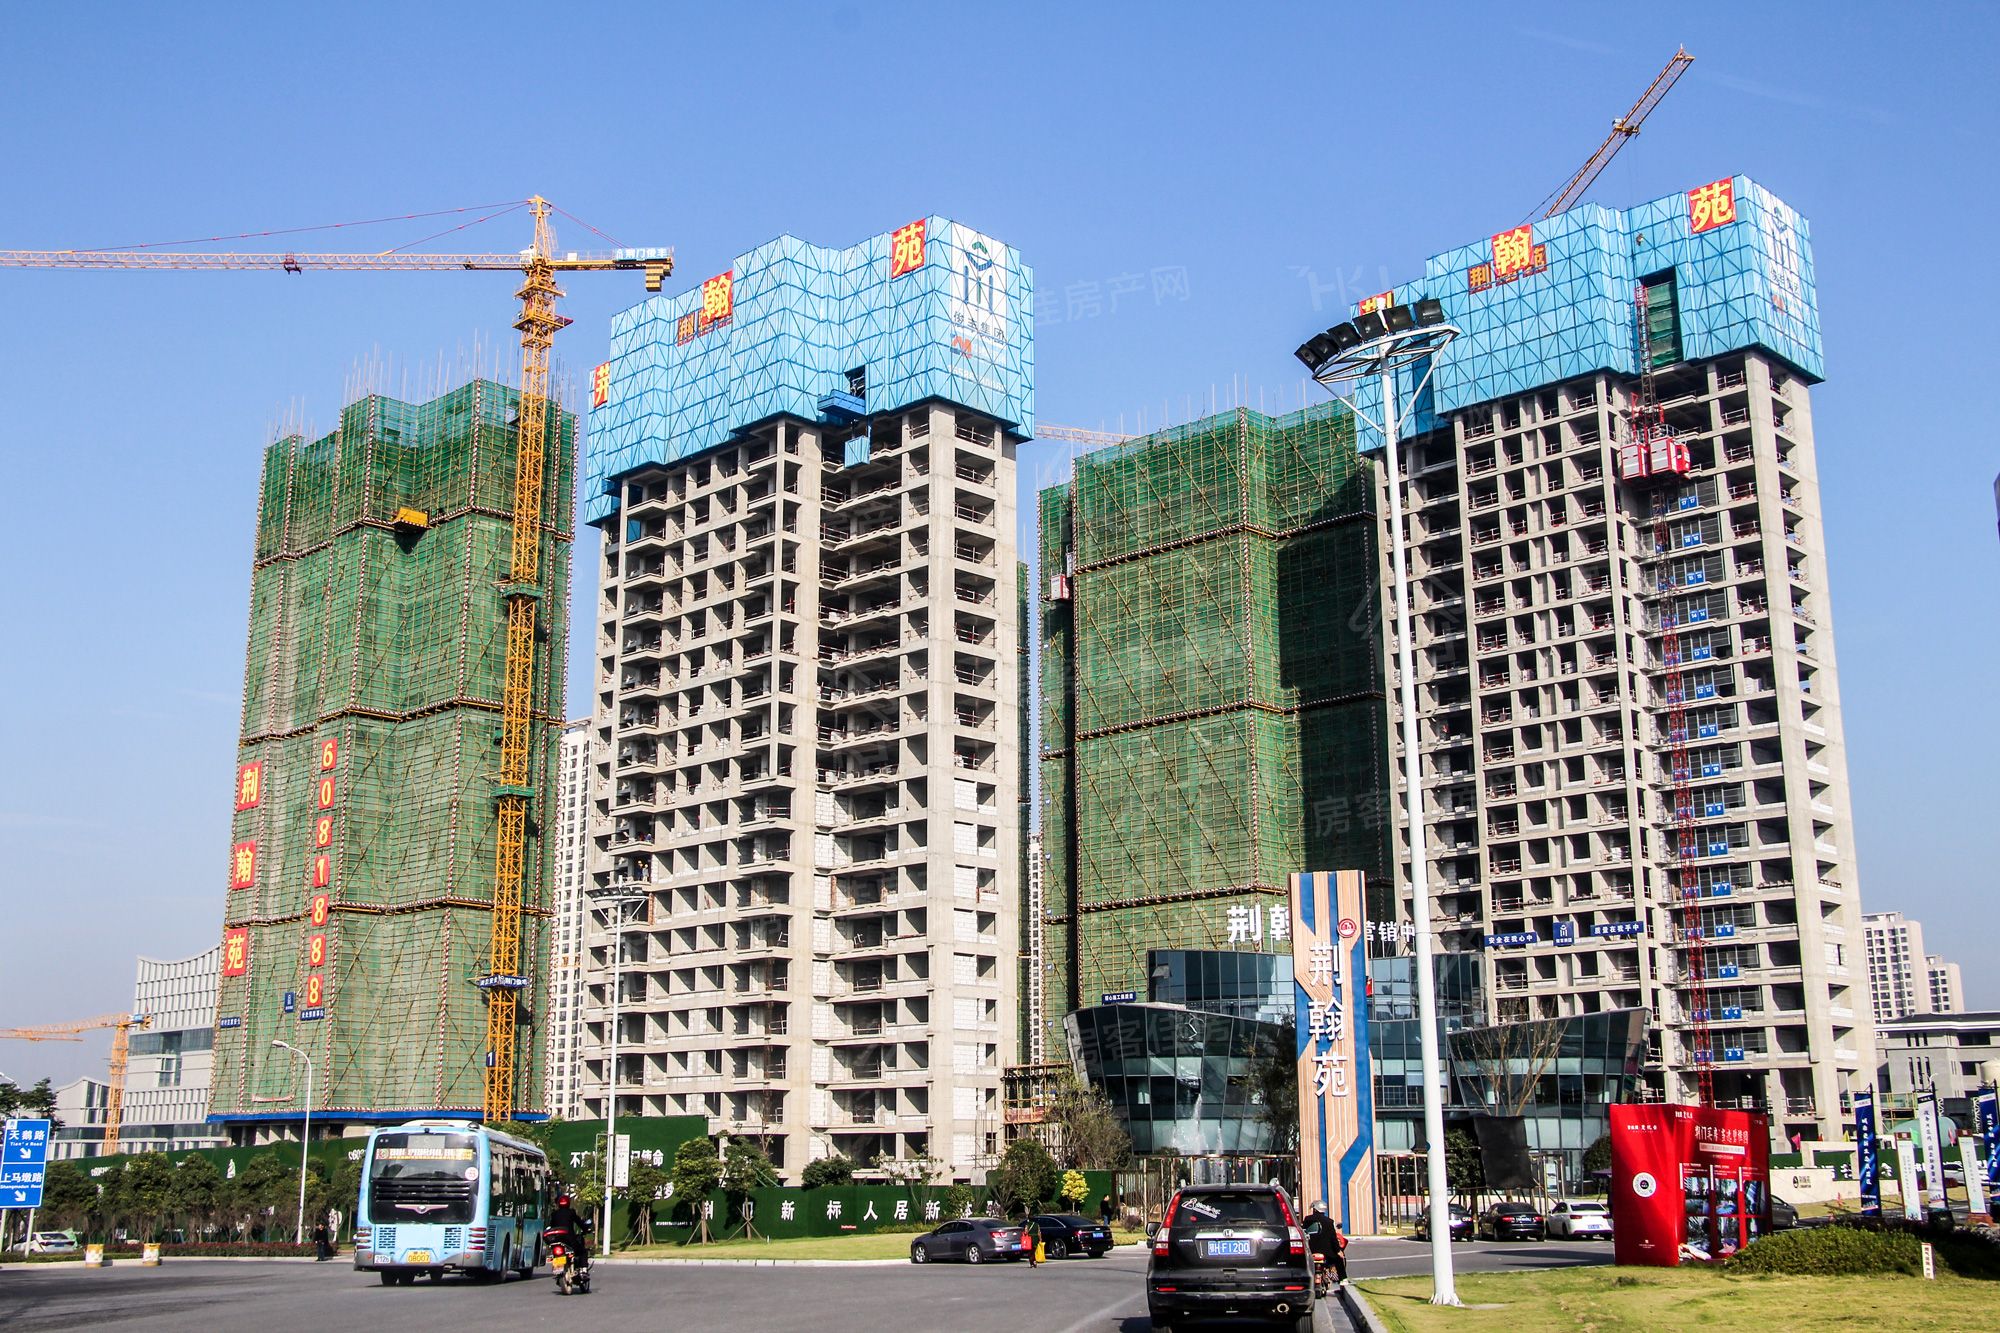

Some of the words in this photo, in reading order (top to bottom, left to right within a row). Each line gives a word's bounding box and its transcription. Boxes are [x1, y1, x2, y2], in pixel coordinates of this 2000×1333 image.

[1488, 934, 1534, 944] 安全在我心中
[1308, 940, 1350, 1097] 荆翰苑
[9, 1130, 46, 1141] 天鹅路
[1, 1172, 43, 1183] 上马墩路
